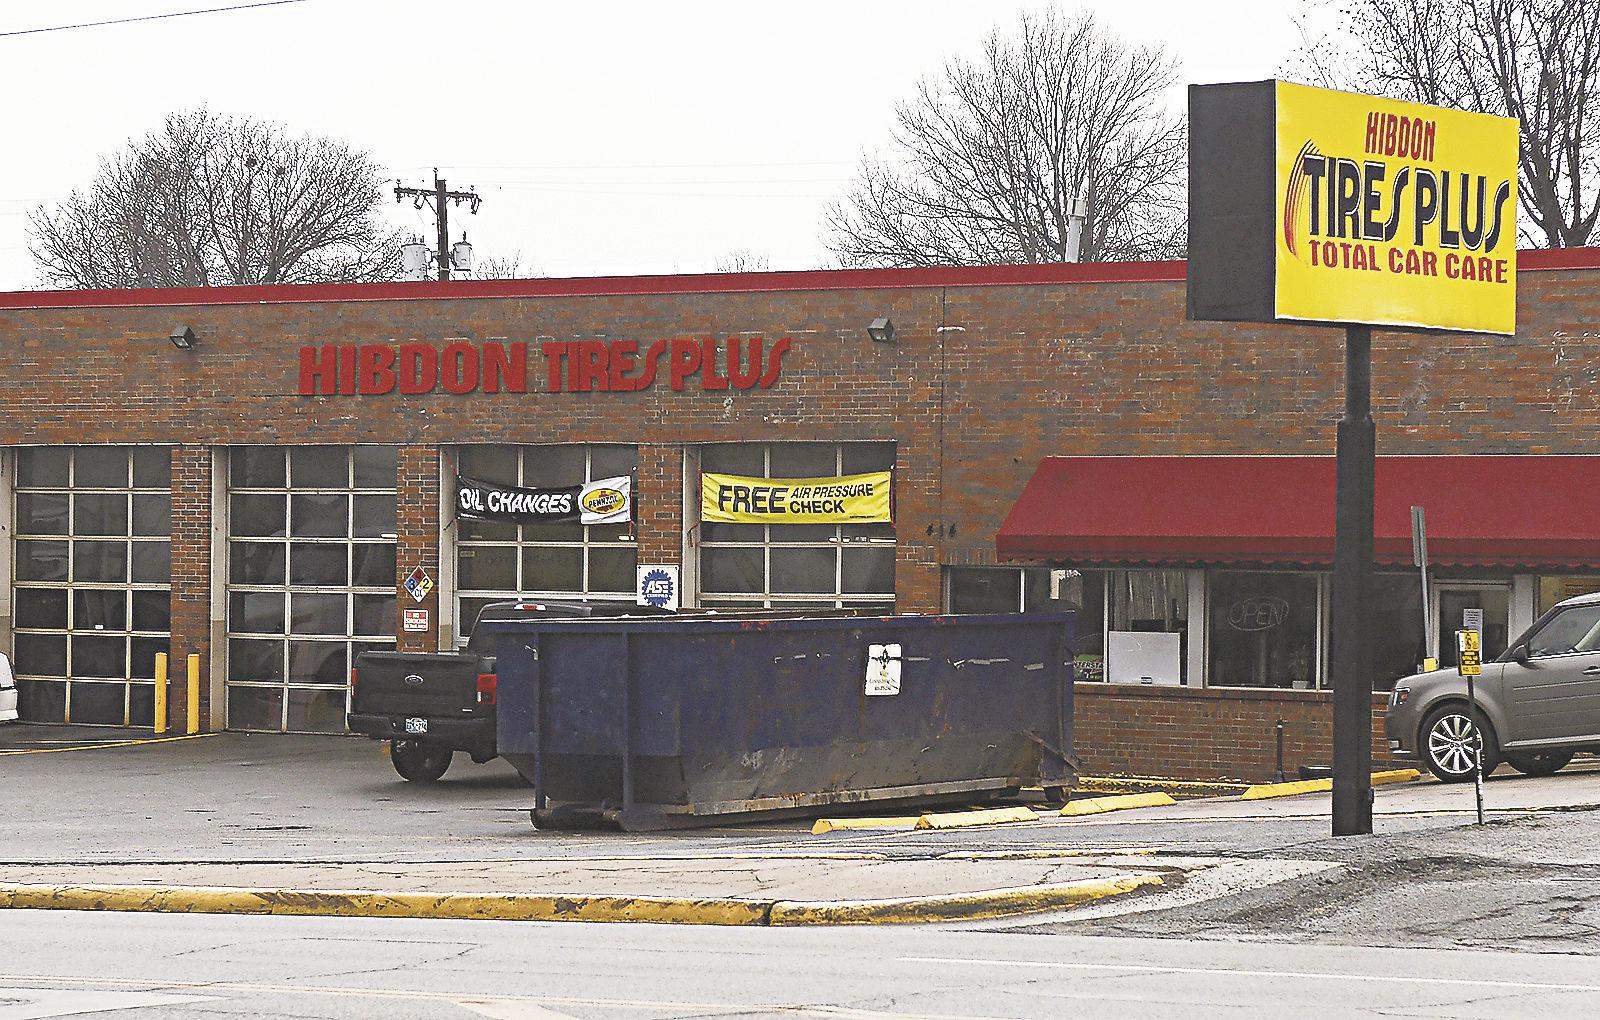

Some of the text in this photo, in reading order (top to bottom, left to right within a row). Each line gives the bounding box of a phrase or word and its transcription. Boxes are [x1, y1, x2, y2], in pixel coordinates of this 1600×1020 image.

[1366, 112, 1436, 162] HIBDON
[1309, 239, 1508, 283] TOTAL CAR CARE
[300, 342, 527, 396] HIBDON
[459, 488, 572, 514] OIL CHANGES
[718, 483, 874, 514] FREE AIR PRESSURE
[789, 500, 846, 514] CHECK
[408, 577, 430, 592] 3 2
[645, 580, 669, 594] ASE
[1230, 602, 1284, 625] OPEN
